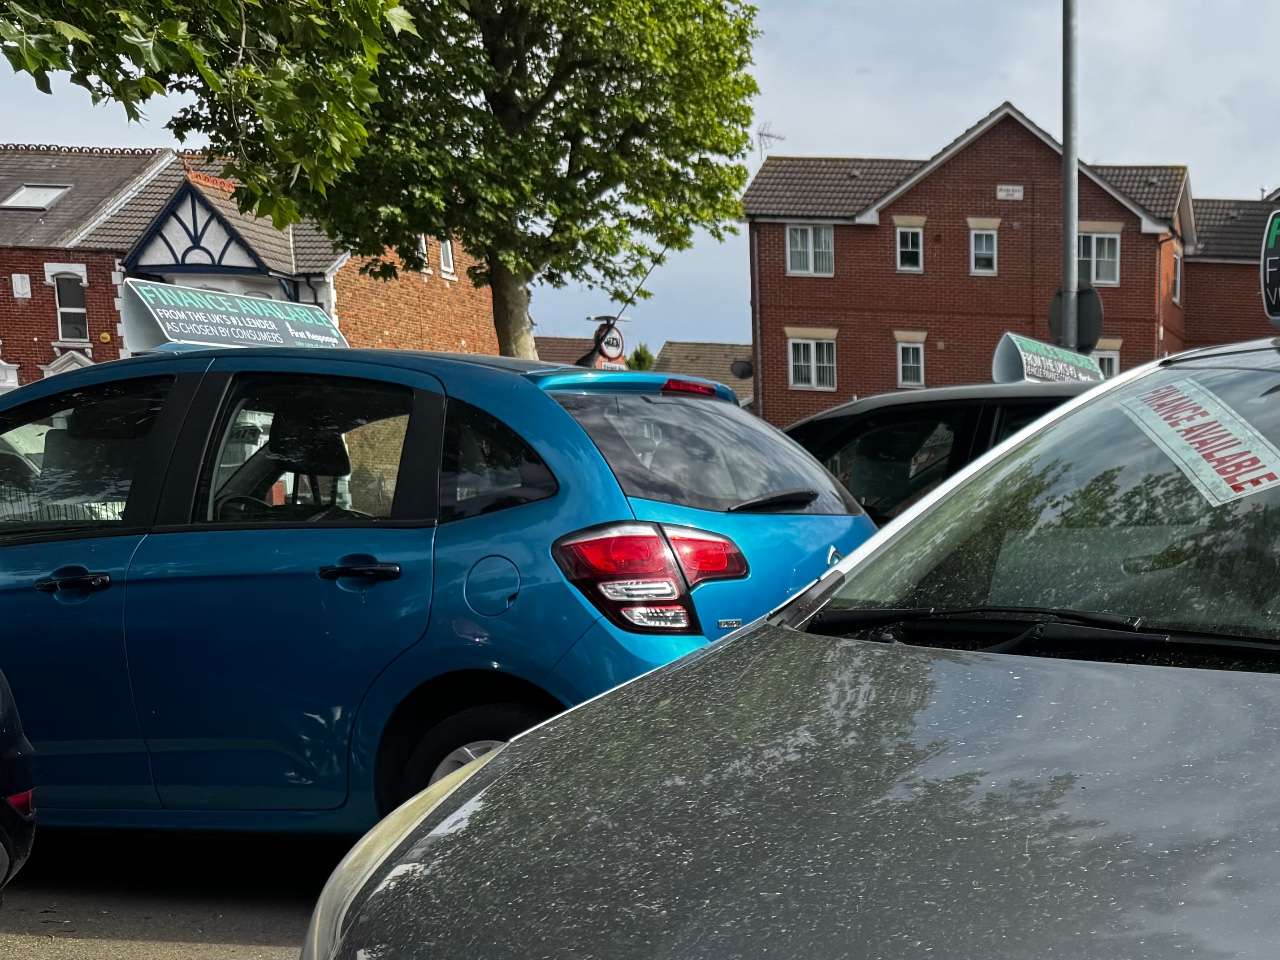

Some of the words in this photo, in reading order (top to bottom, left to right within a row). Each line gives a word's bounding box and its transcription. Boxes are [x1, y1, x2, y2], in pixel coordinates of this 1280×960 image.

[138, 285, 239, 313] FINANCE
[241, 298, 334, 328] AVAILABLE
[158, 308, 186, 322] FROM
[186, 311, 208, 323] THE
[209, 313, 231, 325] UK'S
[242, 318, 277, 331] LENDER
[166, 322, 178, 333] AS
[179, 323, 219, 337] CHOSEN
[220, 327, 231, 337] BY
[231, 327, 283, 344] CONSUMERS
[1176, 420, 1279, 494] AVAILABLE
